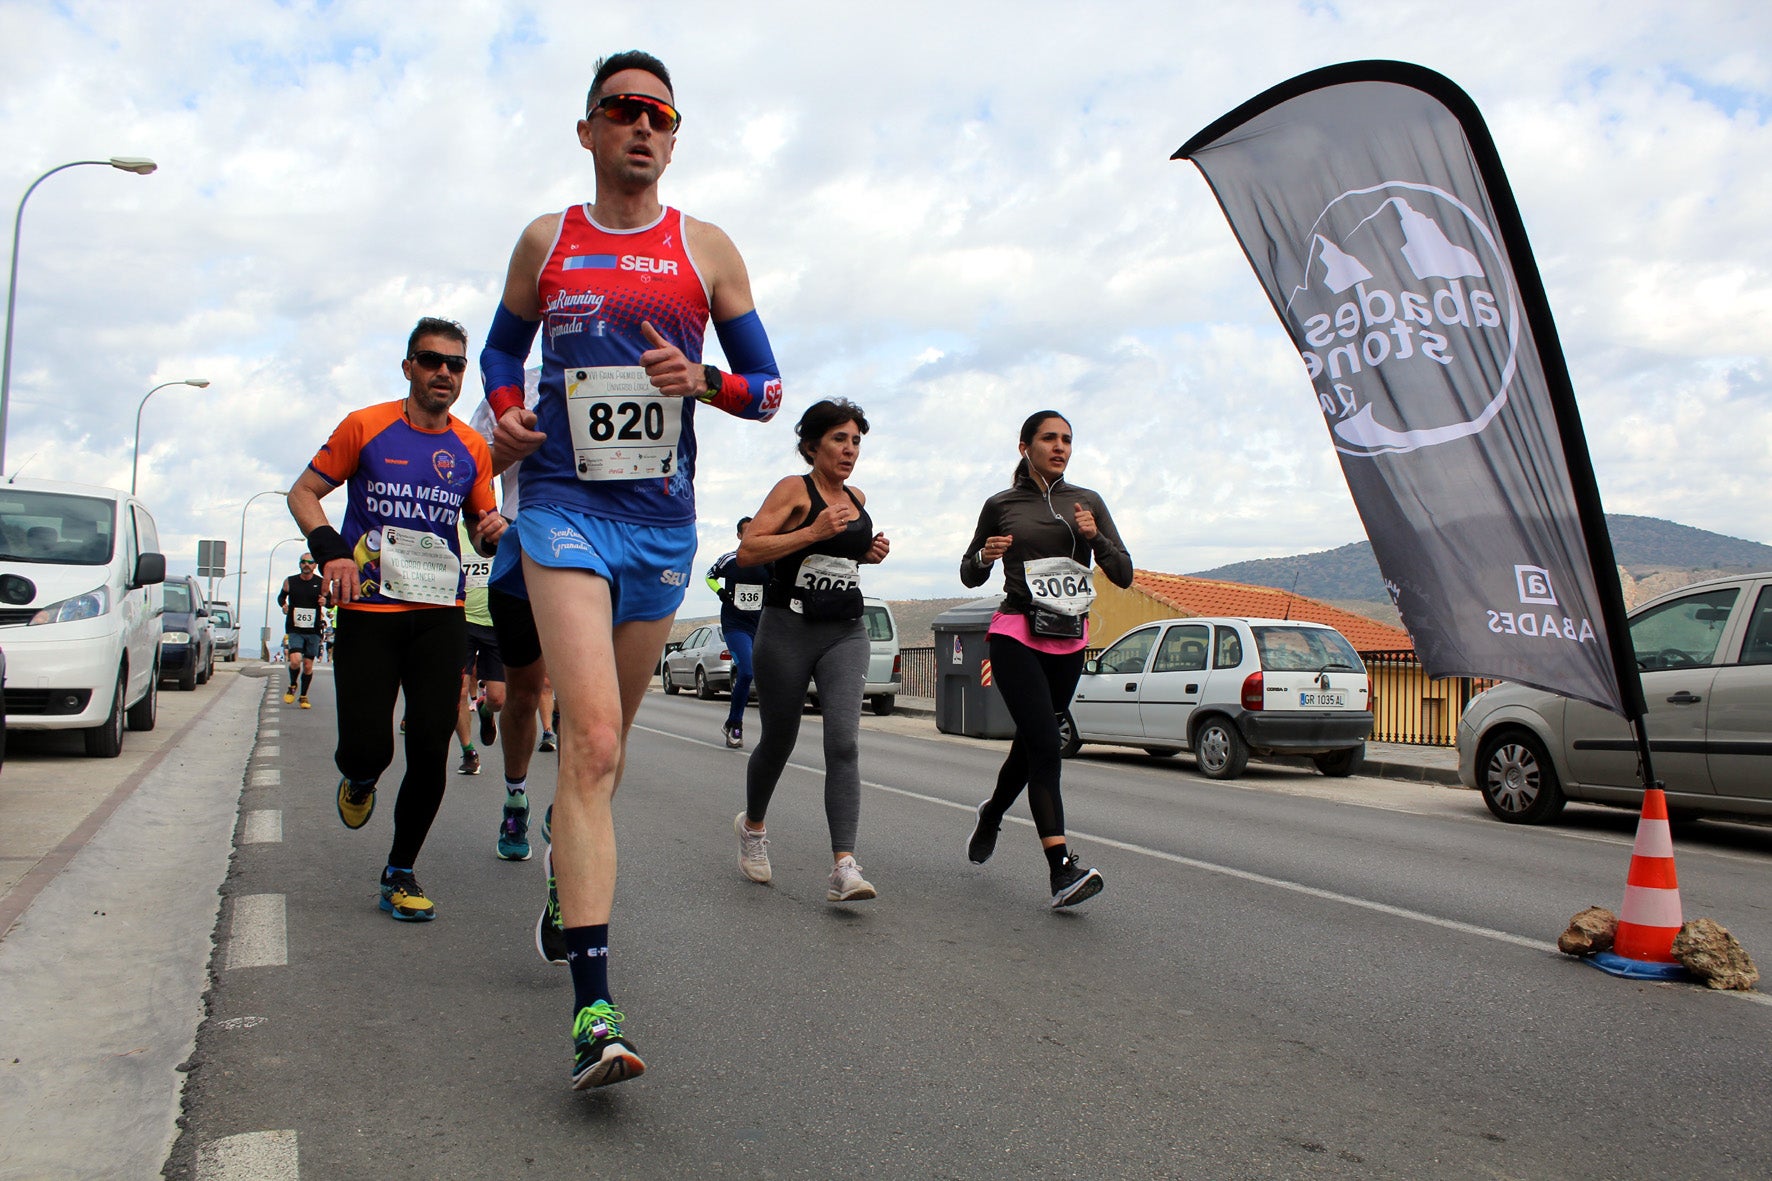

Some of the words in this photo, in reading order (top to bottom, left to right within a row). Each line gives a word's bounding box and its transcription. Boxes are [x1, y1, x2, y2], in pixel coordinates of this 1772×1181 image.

[620, 255, 678, 275] SEUR
[589, 402, 664, 441] 820
[367, 480, 413, 497] DONA
[366, 496, 427, 520] DONA
[463, 563, 489, 576] 725
[1032, 576, 1092, 598] 3064
[740, 592, 759, 602] 336
[297, 614, 312, 622] 263
[1305, 694, 1315, 705] GR
[1317, 695, 1335, 706] 1035
[1336, 696, 1344, 706] AL
